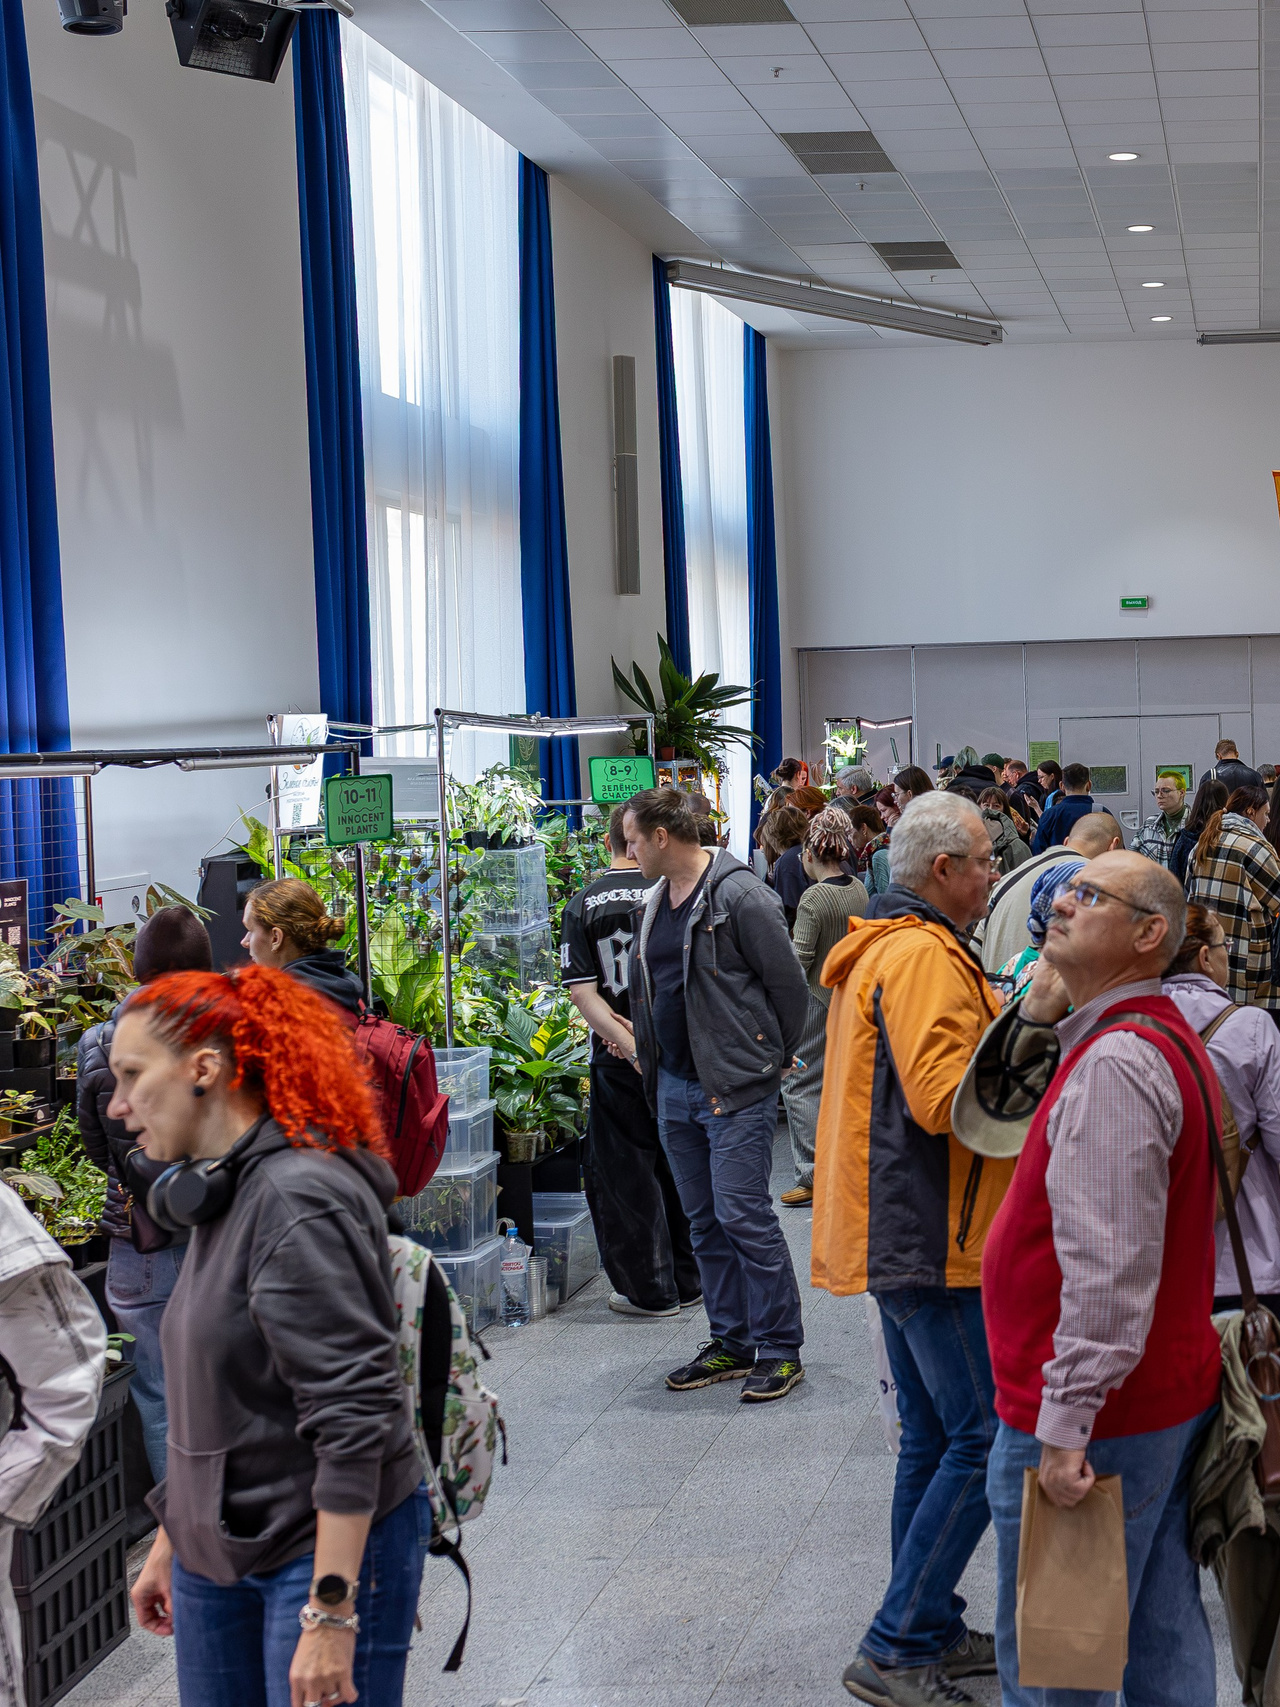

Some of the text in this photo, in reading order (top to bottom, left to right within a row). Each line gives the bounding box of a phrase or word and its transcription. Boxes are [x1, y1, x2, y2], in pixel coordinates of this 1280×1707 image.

[610, 765, 632, 776] 8-9
[602, 783, 644, 792] ЗЕЛЁНОЕ
[343, 787, 376, 804] 10-11
[337, 812, 385, 826] INNOCENT
[345, 823, 379, 836] PLANTS
